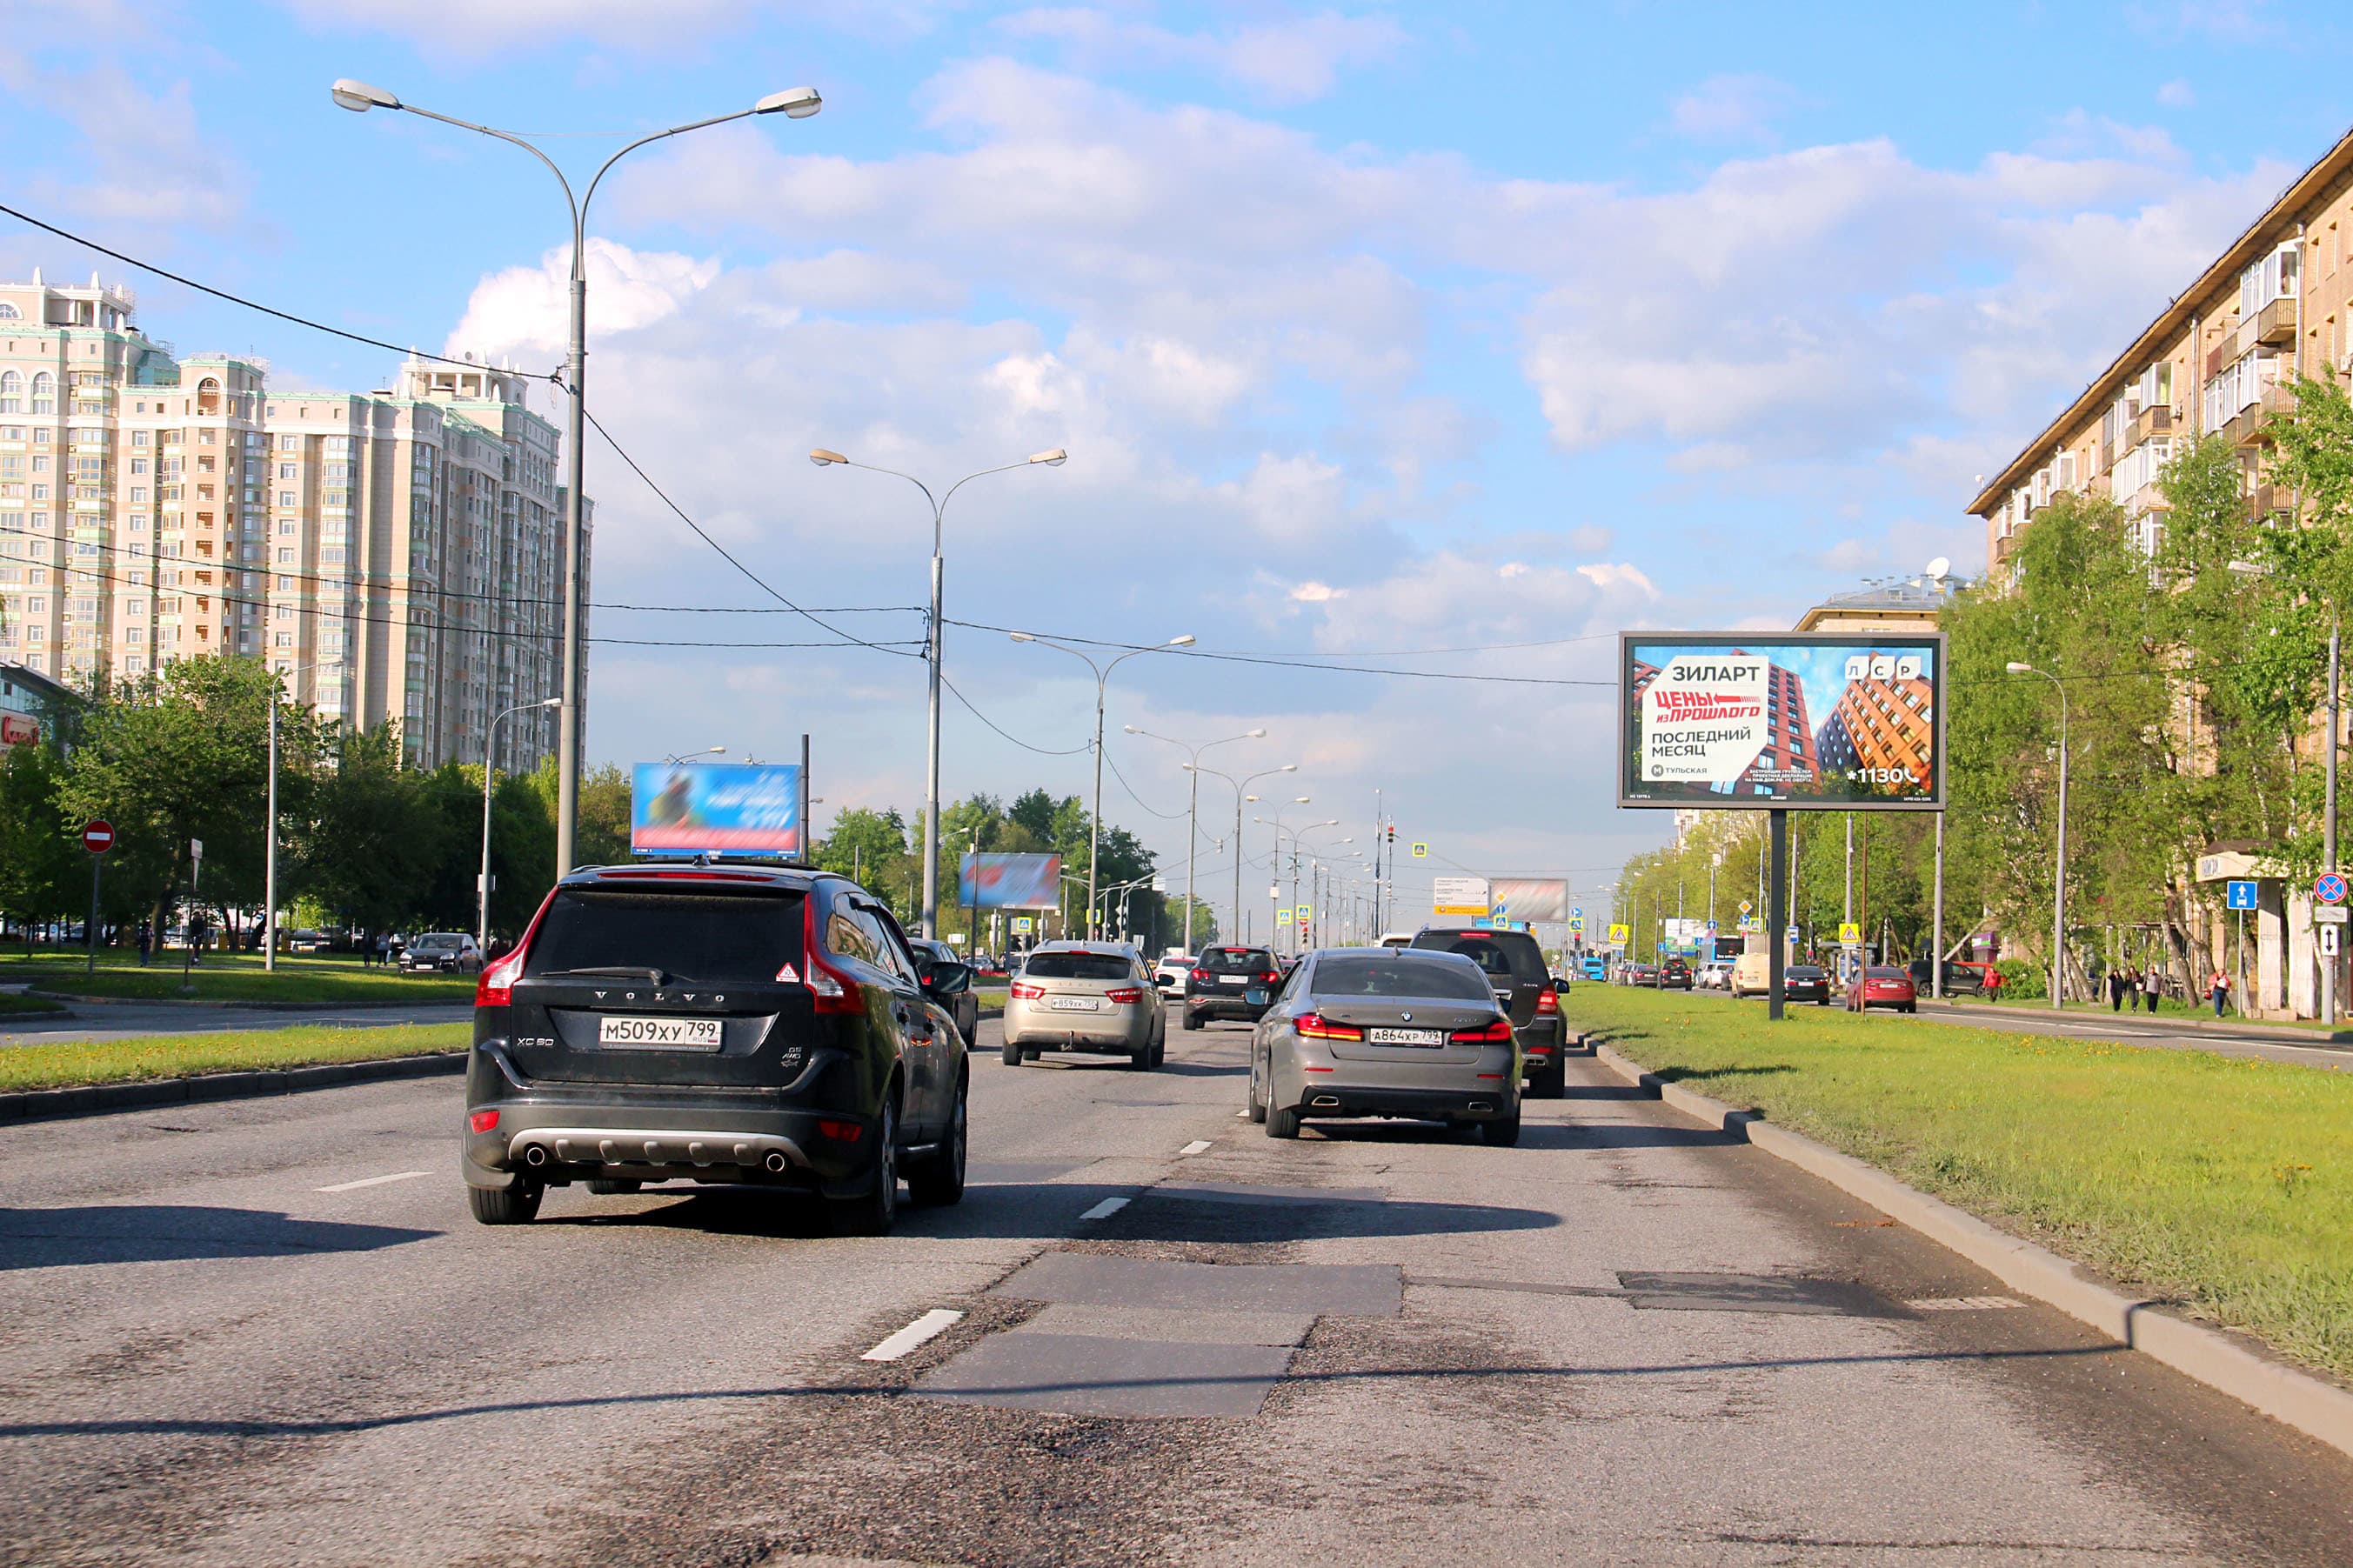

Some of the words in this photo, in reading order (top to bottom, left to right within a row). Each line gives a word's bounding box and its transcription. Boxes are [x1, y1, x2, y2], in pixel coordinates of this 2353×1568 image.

[1672, 666, 1760, 682] ЗИЛАРТ
[1654, 691, 1714, 710] ЦЕНЫ
[1670, 706, 1761, 723] ПРОШЛОГО
[1652, 726, 1751, 744] ПОСЛЕДНИЙ
[1652, 744, 1706, 757] МЕСЯЦ
[594, 991, 725, 1002] VOLVO
[687, 1022, 716, 1037] 799
